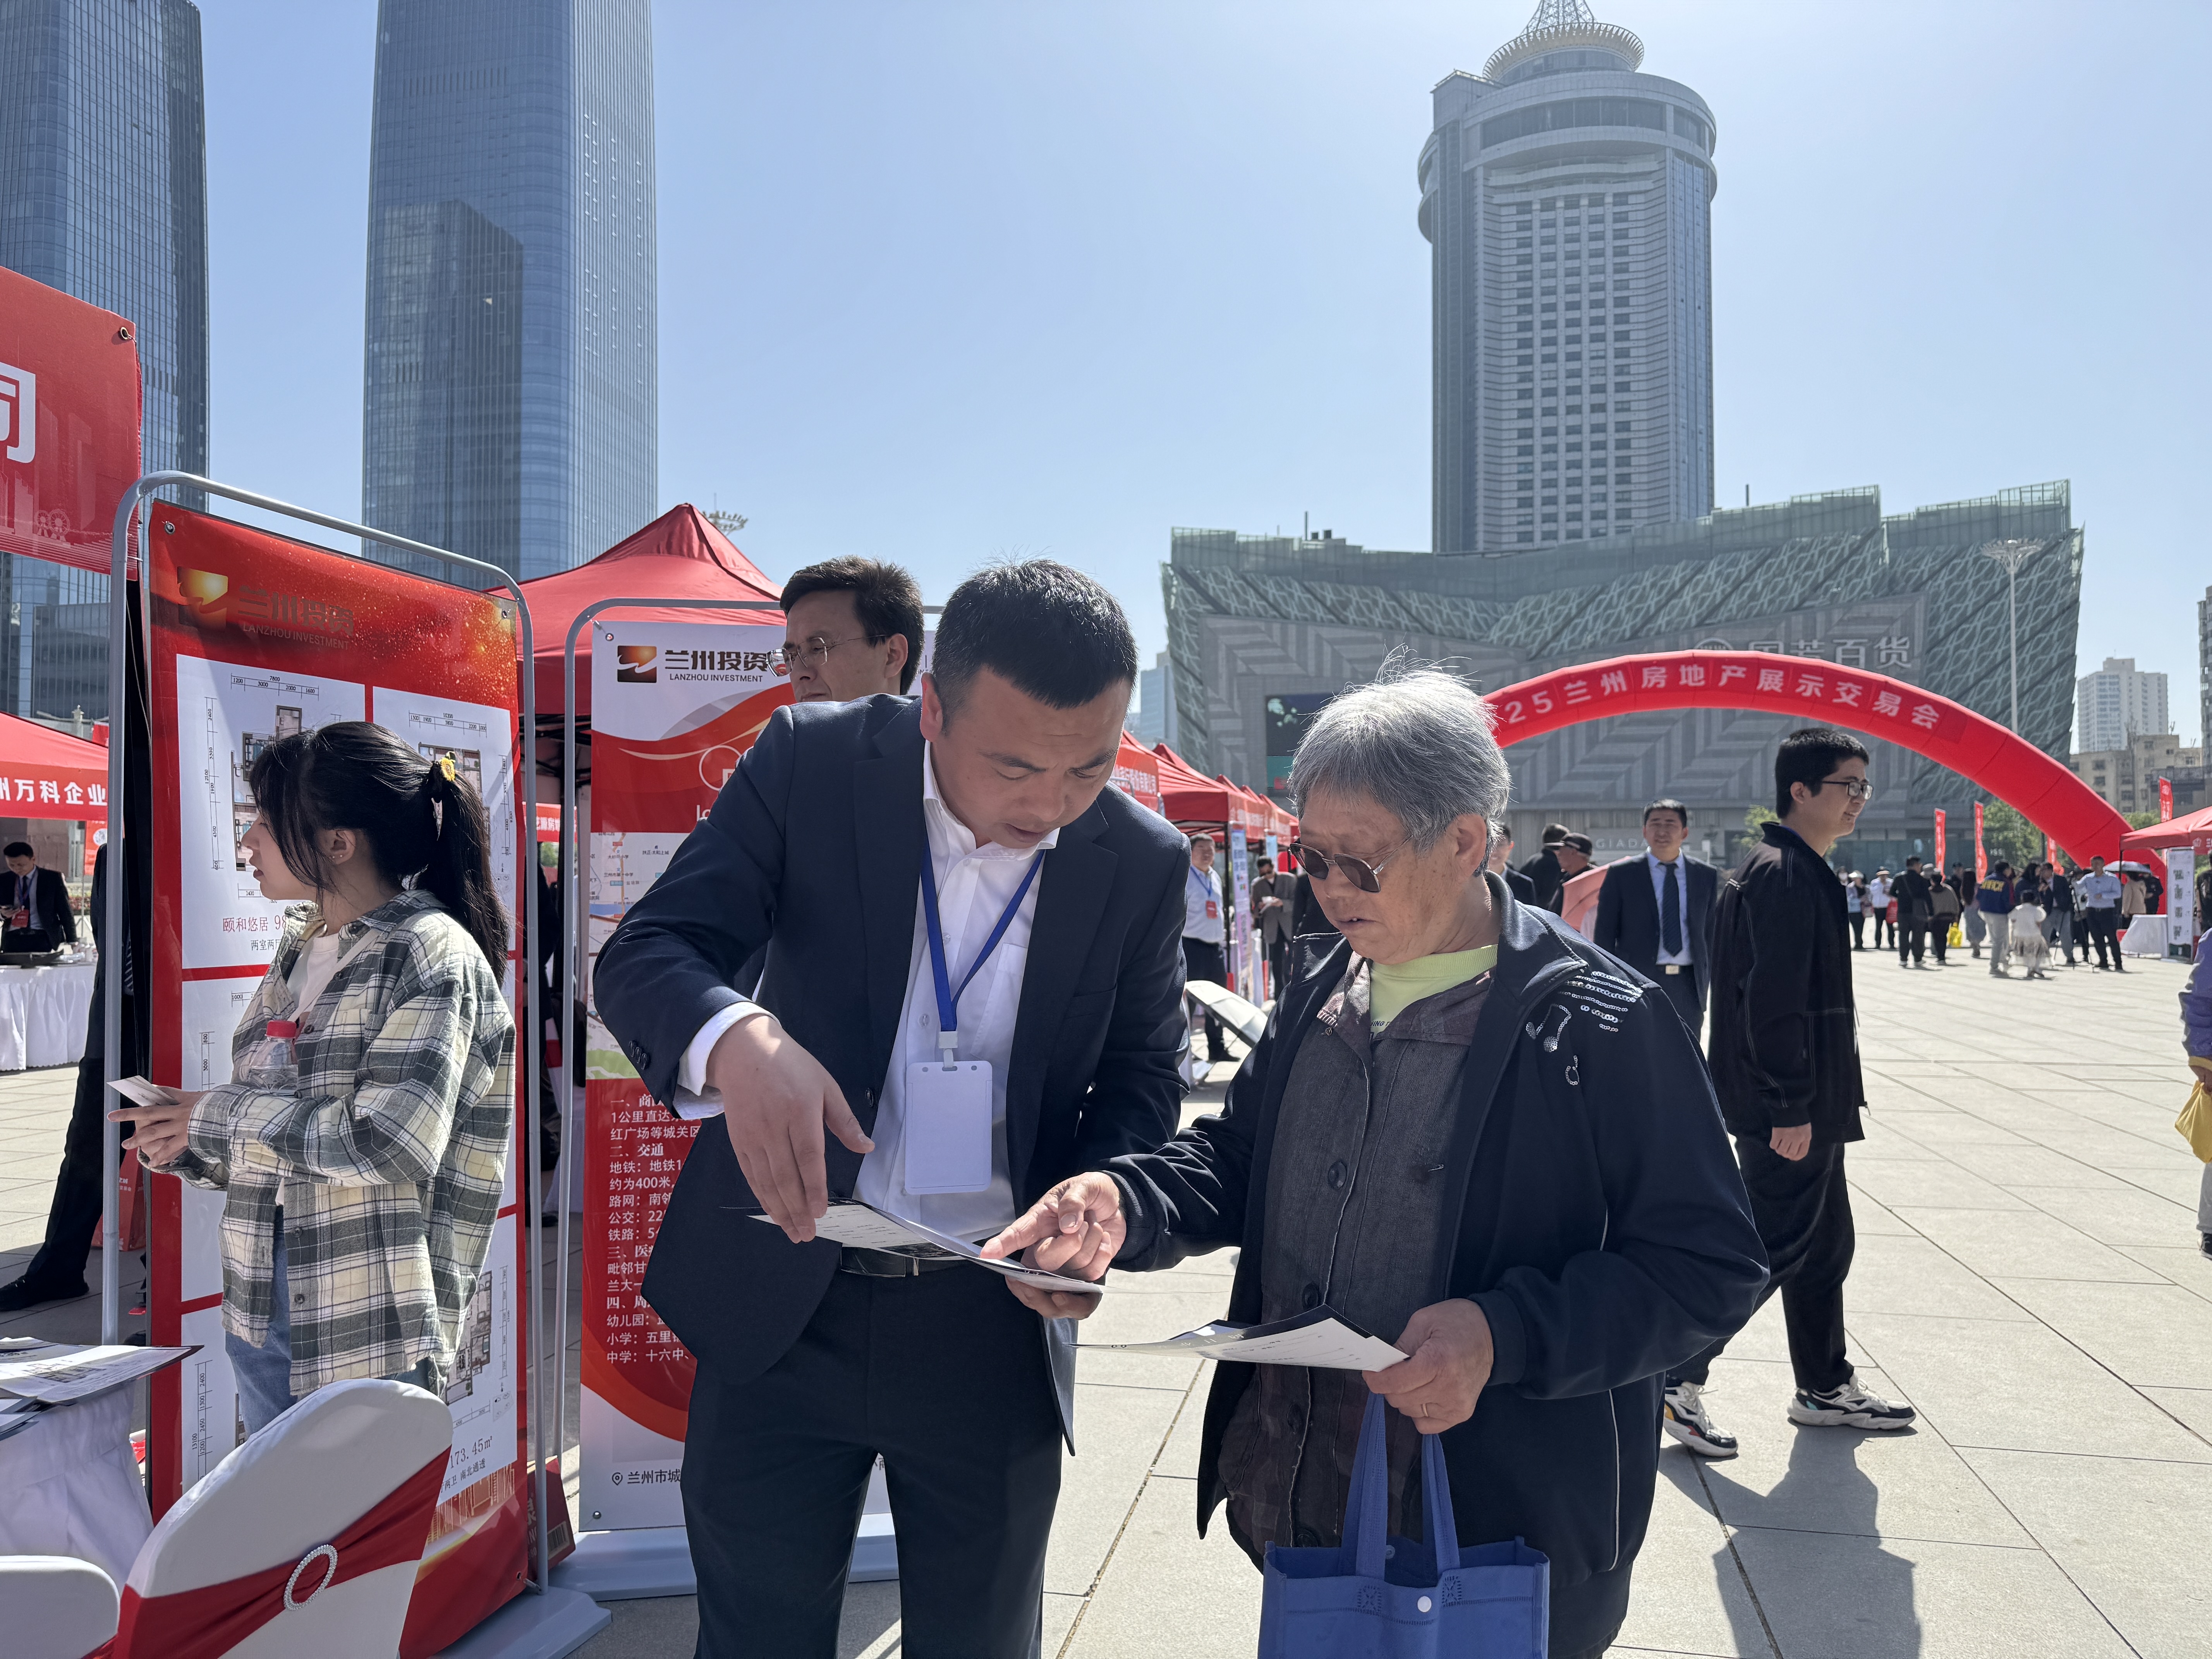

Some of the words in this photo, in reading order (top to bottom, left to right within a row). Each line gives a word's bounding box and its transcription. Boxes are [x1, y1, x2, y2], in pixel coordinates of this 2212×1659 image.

[238, 585, 354, 637] 兰州投资
[243, 622, 290, 639] LANZHOU
[293, 631, 349, 650] INVESTMENT
[665, 650, 768, 672] 兰州投资
[1504, 663, 1939, 730] 25兰州房地产展示交易会
[1595, 838, 1649, 849] GIADA
[223, 917, 268, 933] 颐和悠居
[610, 1125, 700, 1140] 红广场等城关区
[610, 1142, 664, 1157] 二、交通
[608, 1210, 666, 1224] 公交：22
[608, 1227, 661, 1241] 铁路：5
[607, 1261, 647, 1275] 毗邻甘
[460, 1458, 486, 1480] 南北通透
[627, 1468, 680, 1484] 兰州市城
